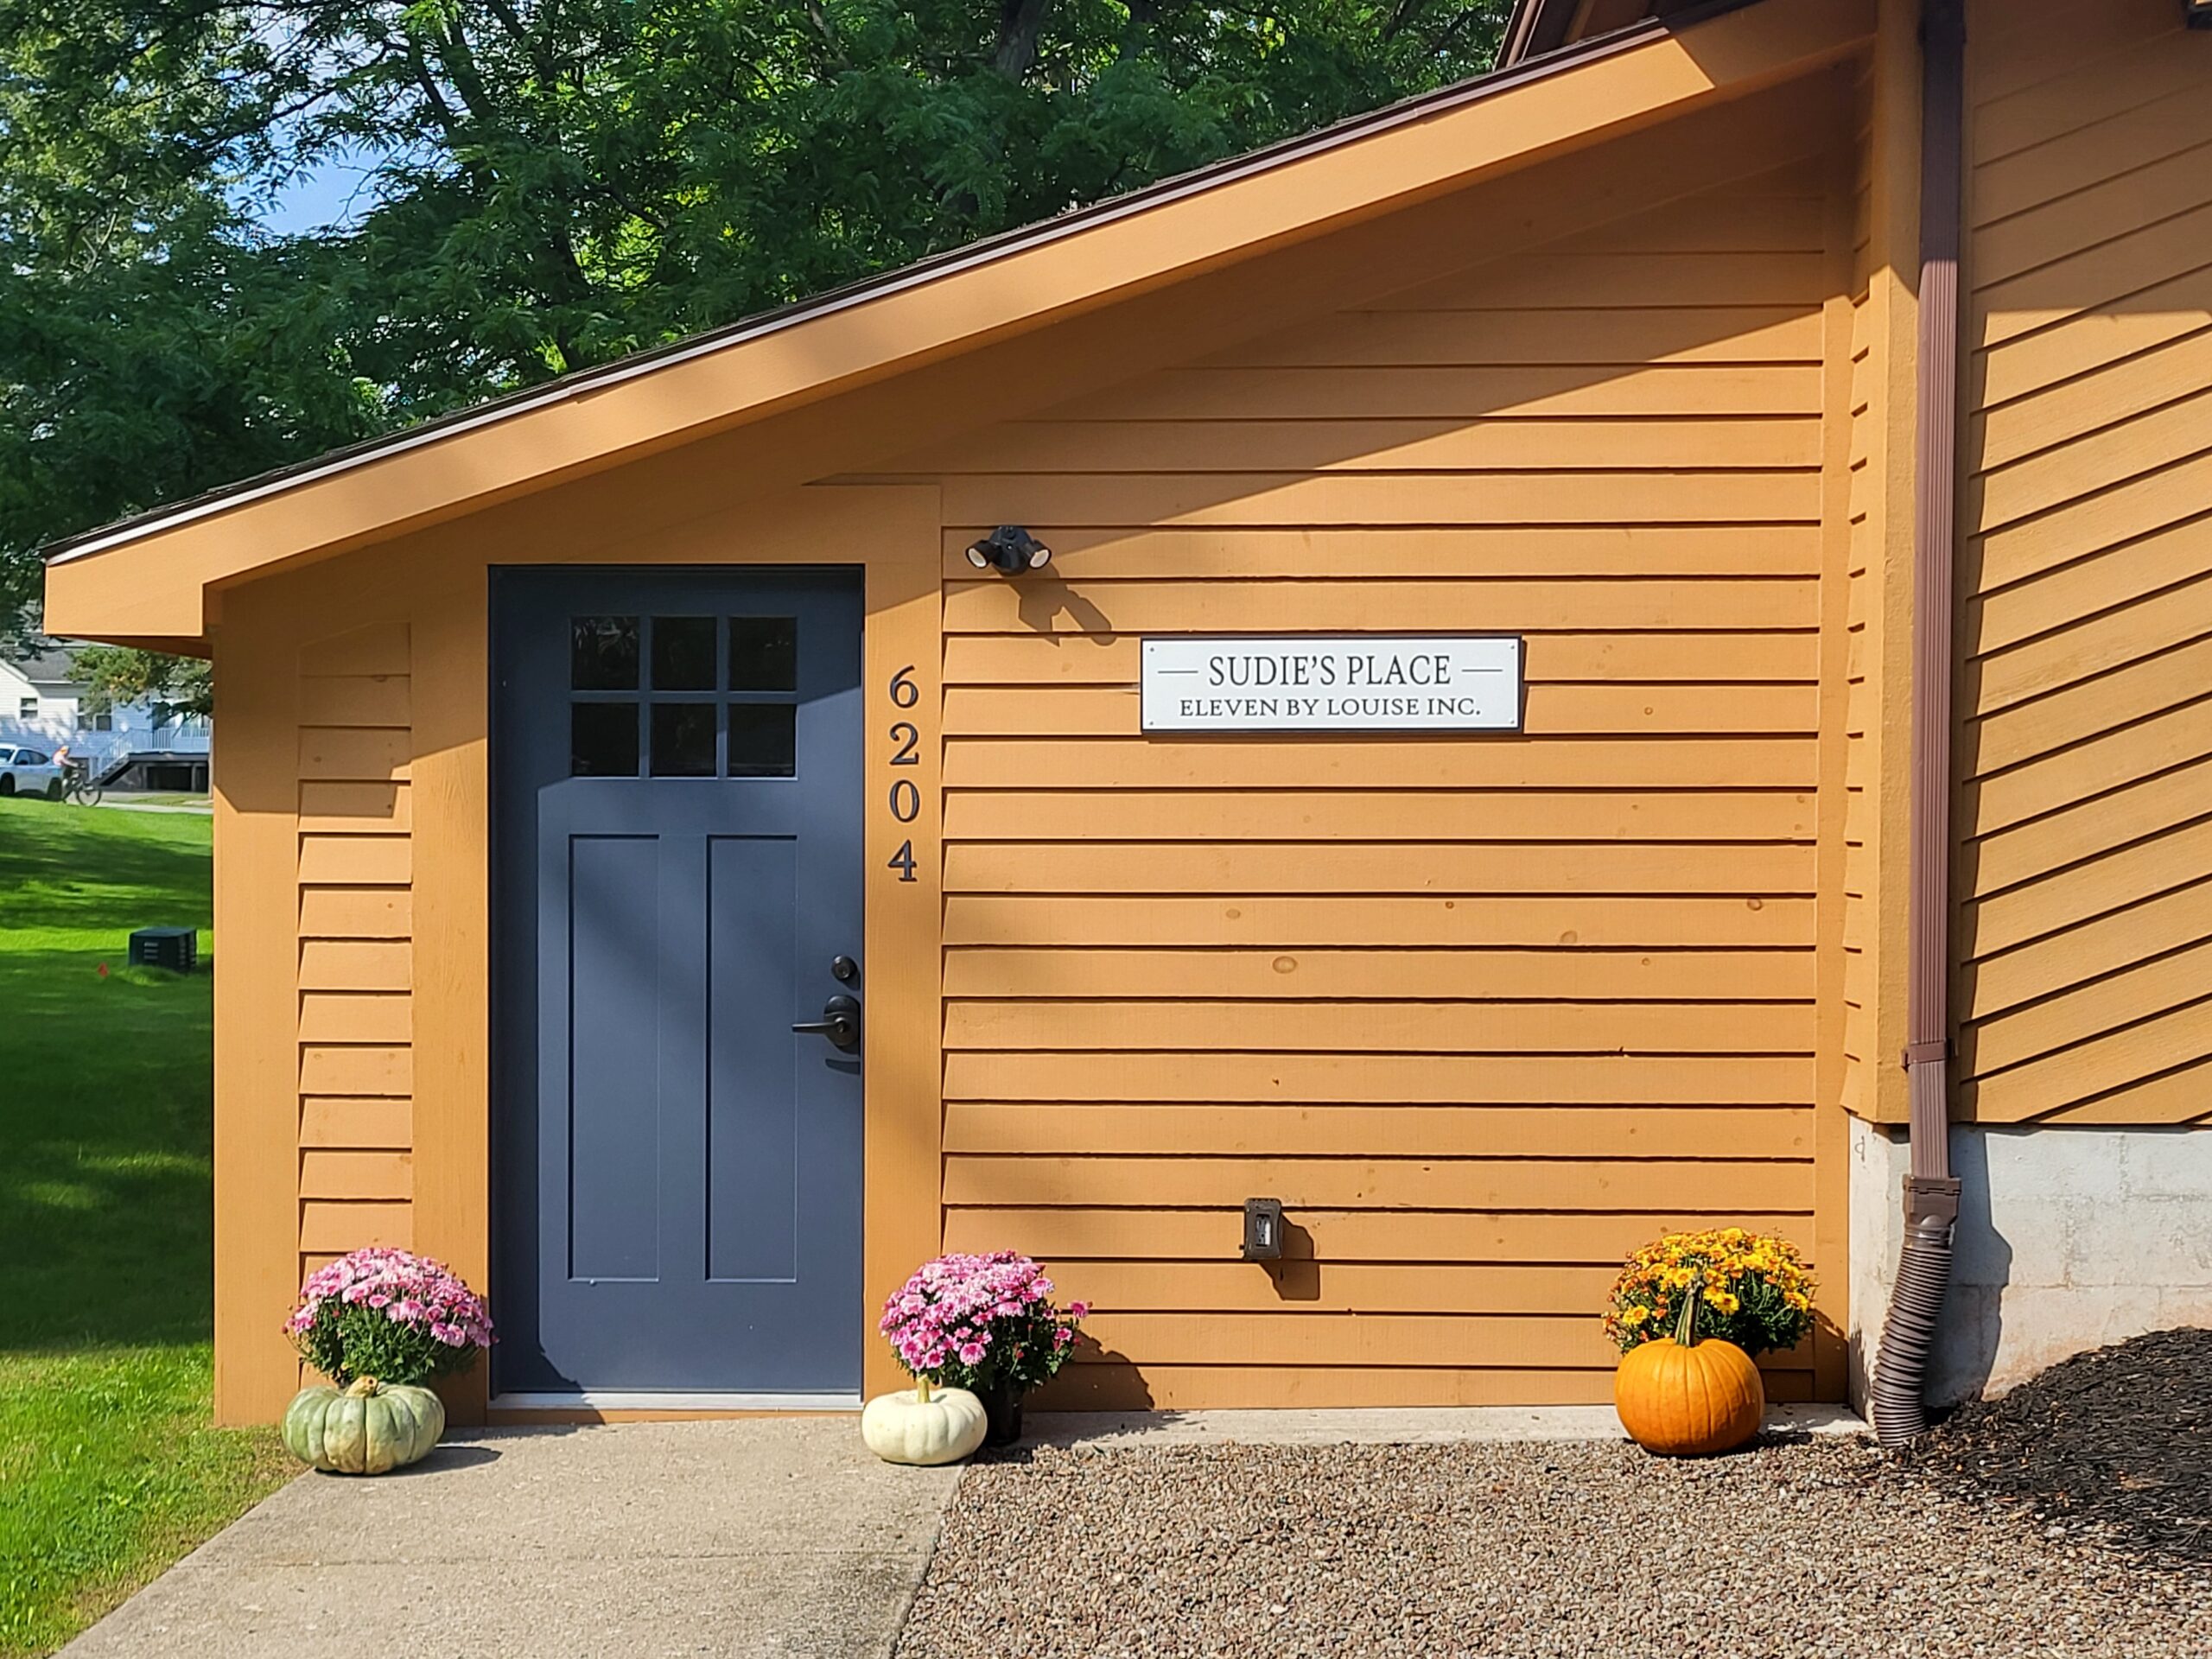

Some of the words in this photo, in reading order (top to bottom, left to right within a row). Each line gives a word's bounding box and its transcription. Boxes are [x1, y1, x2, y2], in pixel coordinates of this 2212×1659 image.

[1209, 655, 1336, 686] SUDIE'S
[1346, 654, 1452, 685] PLACE
[1179, 699, 1279, 717] ELEVEN
[1286, 698, 1319, 716] BY
[1327, 698, 1420, 716] LOUISE
[1427, 697, 1481, 715] INC.
[887, 664, 920, 882] 6204
